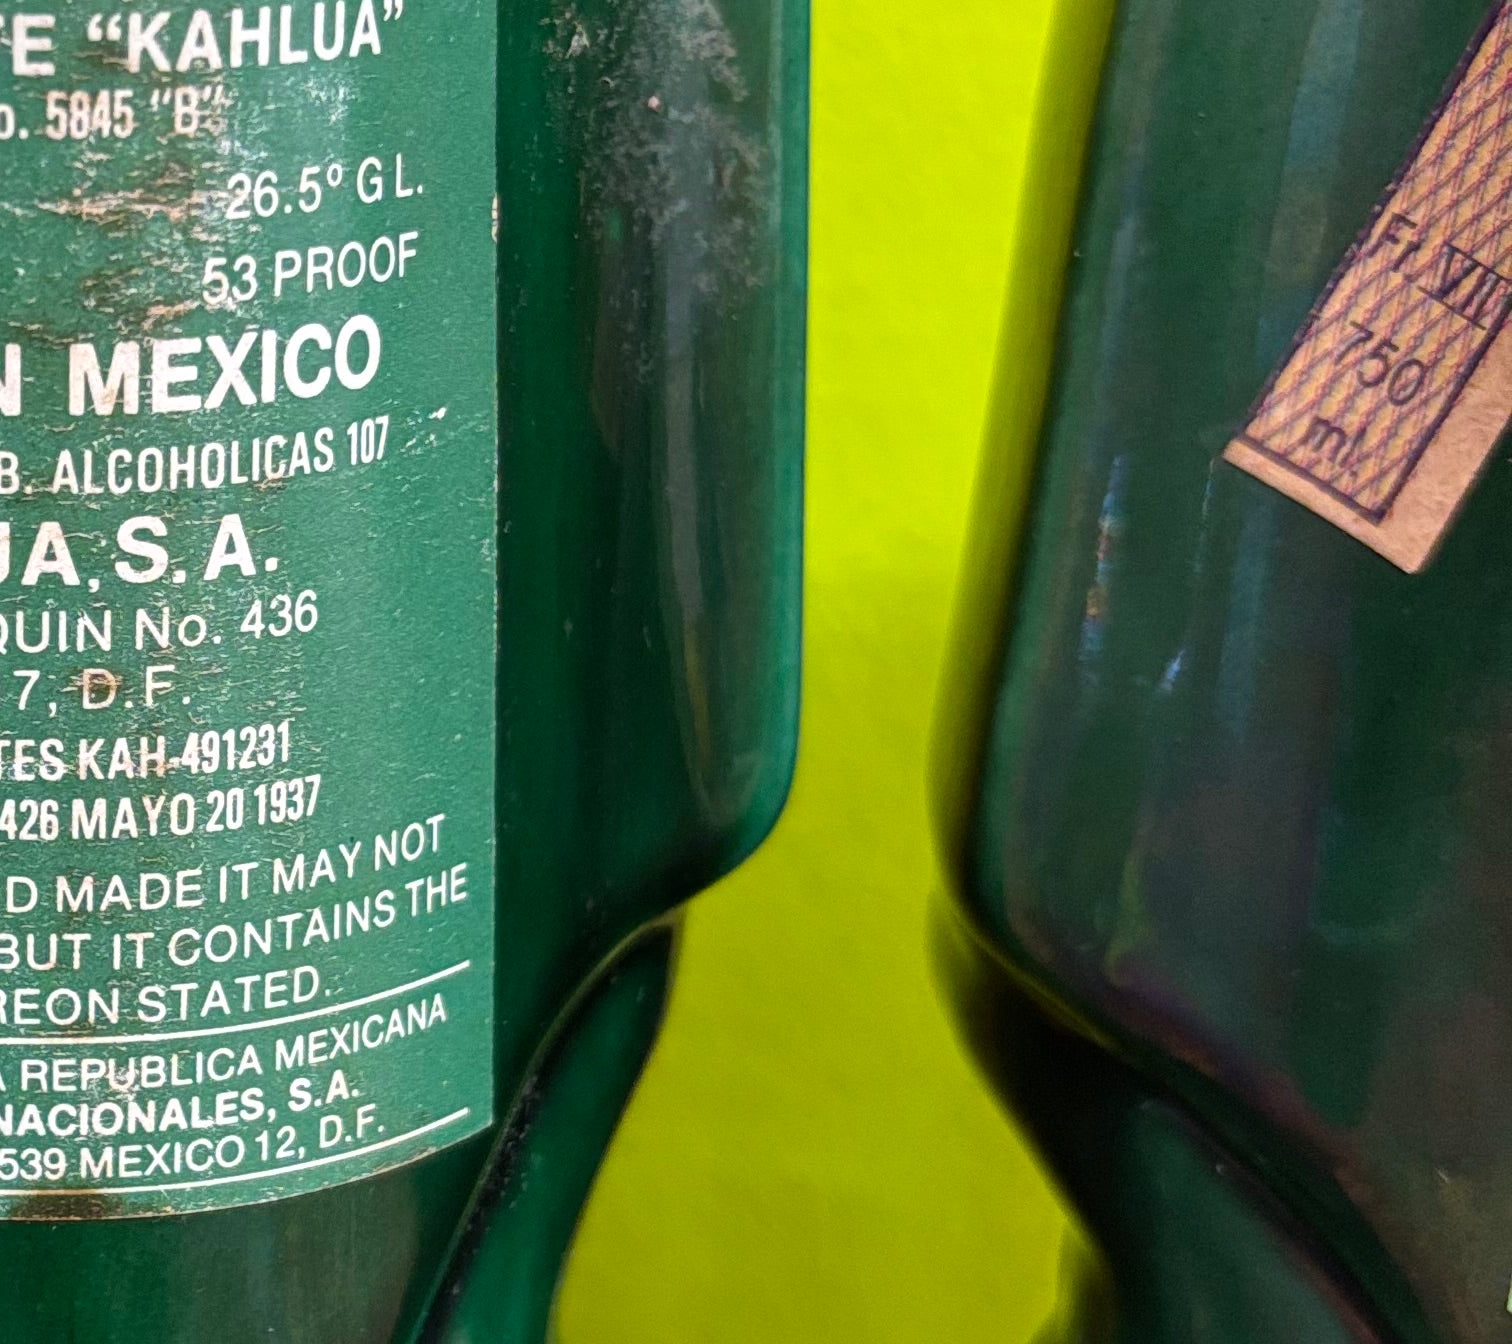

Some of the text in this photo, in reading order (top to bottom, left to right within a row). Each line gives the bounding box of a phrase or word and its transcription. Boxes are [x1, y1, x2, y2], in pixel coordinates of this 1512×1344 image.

[46, 89, 135, 140] 5845
[203, 231, 419, 306] 53 PROOF
[69, 314, 381, 416] MEXICO
[1335, 321, 1426, 406] 750
[52, 427, 334, 495] ALCOHOLICAS
[347, 415, 389, 466] 107
[135, 606, 221, 651] No.
[240, 589, 318, 639] 436
[72, 792, 196, 840] MAYO
[206, 787, 244, 833] 20
[254, 774, 321, 825] 1937
[57, 870, 202, 913] MADE
[220, 861, 259, 903] IT
[273, 841, 361, 894] MAY
[374, 812, 446, 871] NOT
[112, 932, 155, 970] IT
[168, 890, 396, 966] CONTAINS
[405, 862, 468, 918] THE
[21, 1044, 263, 1092] REPUBLICA
[275, 993, 448, 1072] MEXICANA
[288, 1069, 360, 1112] S.A.
[80, 1135, 246, 1179] MEXICO
[255, 1125, 305, 1161] 12,
[319, 1103, 386, 1149] D.F.
